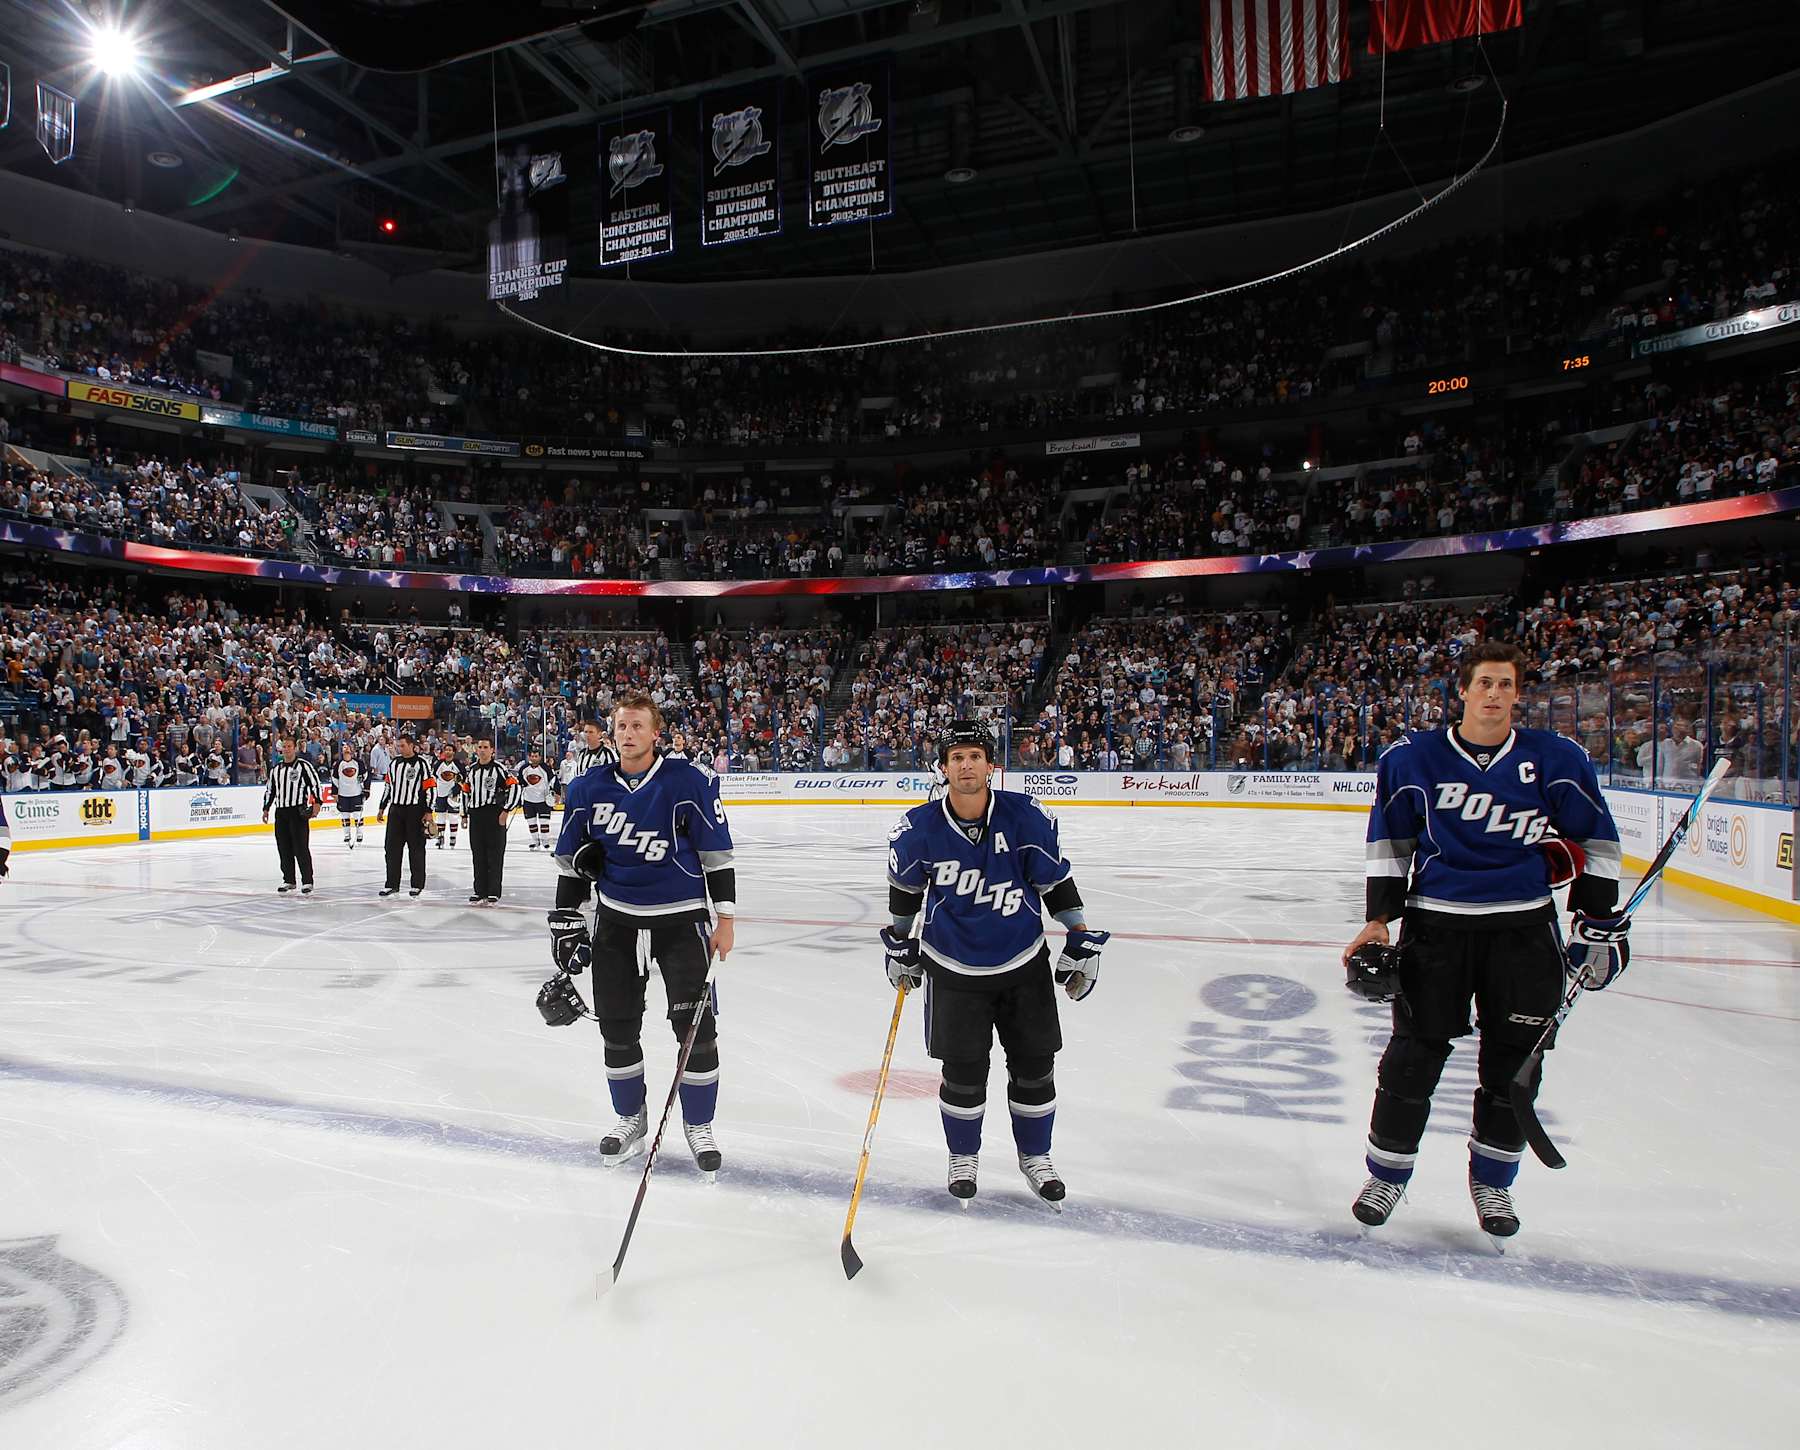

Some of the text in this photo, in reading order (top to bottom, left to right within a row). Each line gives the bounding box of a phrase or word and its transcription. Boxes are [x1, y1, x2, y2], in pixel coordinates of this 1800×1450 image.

[814, 160, 886, 182] SOUTHEAST
[707, 179, 775, 202] SOUTHEAST
[823, 176, 876, 197] DIVISION
[715, 196, 767, 217] DIVISION
[815, 190, 885, 212] CHAMPIONS
[611, 203, 660, 223] EASTERN
[708, 209, 775, 232] CHAMPIONS
[602, 215, 669, 238] CONFERENCE
[605, 229, 667, 252] CHAMPIONS
[489, 259, 567, 284] STANLEY CUP
[495, 273, 562, 296] CHAMPIONS
[518, 290, 539, 302] 2004
[1562, 355, 1590, 370] 7:35
[1427, 376, 1469, 394] 20:00
[547, 447, 566, 457] Fast
[567, 449, 590, 457] news
[591, 449, 606, 459] you
[607, 450, 625, 458] can
[1024, 775, 1053, 785] ROSE
[1121, 774, 1200, 791] Brickwall
[1253, 775, 1320, 783] FAMILY PACK
[1517, 761, 1536, 784] C
[794, 779, 888, 789] BUD LIGHT
[1024, 786, 1078, 797] RADIOLOGY
[15, 801, 60, 819] Times
[140, 790, 148, 829] Reebok
[1434, 782, 1549, 846] BOLTS
[592, 802, 670, 862] BOLTS
[1707, 813, 1728, 835] bright
[994, 831, 1010, 854] A
[1707, 834, 1728, 855] house
[933, 860, 1024, 917] BOLTS
[673, 1000, 711, 1011] BAUR
[1164, 1021, 1346, 1125] ROSE
